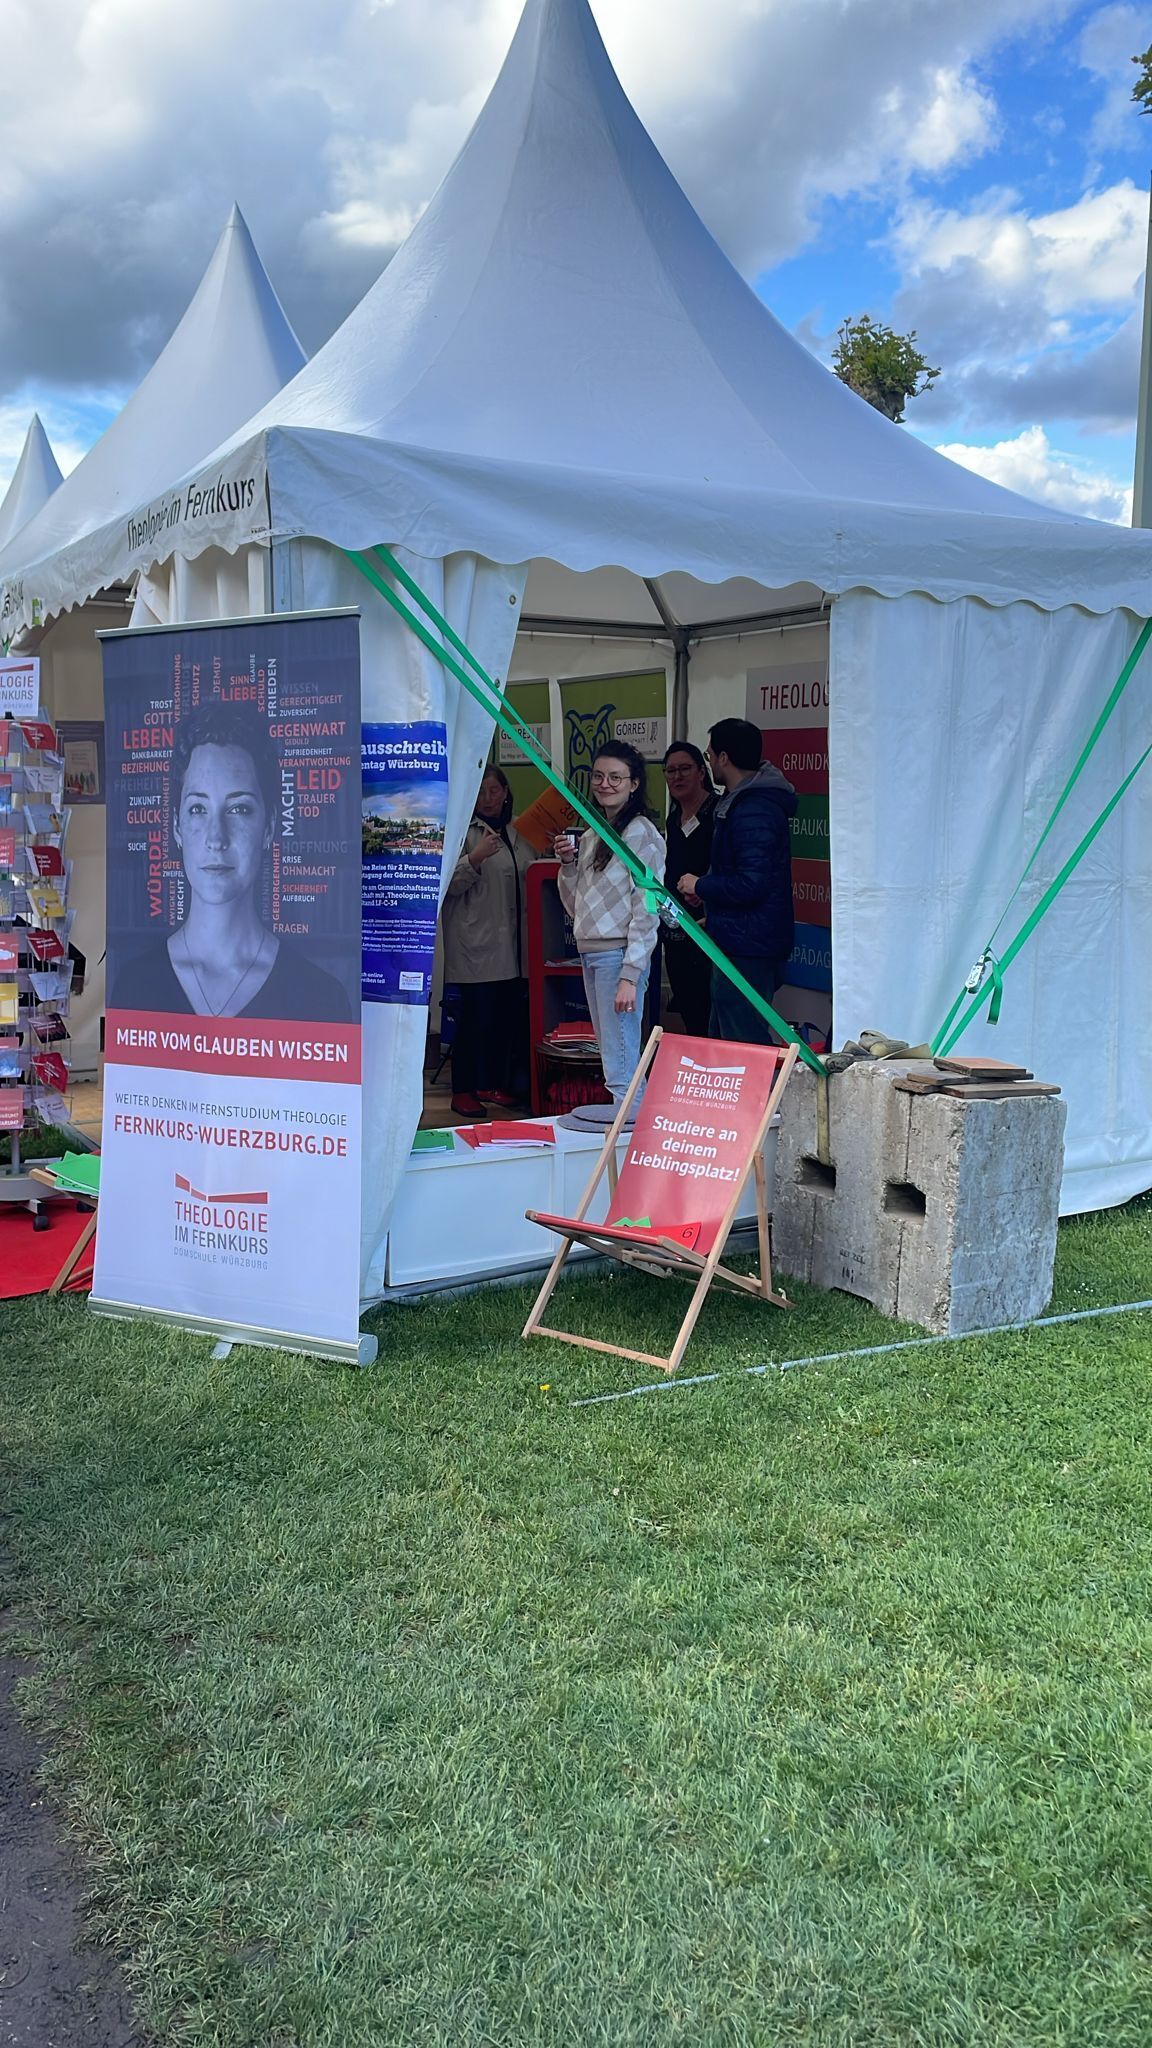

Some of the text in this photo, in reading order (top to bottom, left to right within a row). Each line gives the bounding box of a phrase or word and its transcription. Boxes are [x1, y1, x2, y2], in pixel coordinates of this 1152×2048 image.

[127, 474, 255, 551] Theologie im Fernkurs
[192, 664, 200, 706] SCHUTZ
[230, 675, 250, 686] SINN
[268, 658, 276, 717] FRIEDEN
[222, 686, 257, 701] LIEBE
[280, 694, 343, 707] GERECHTIGKEIT
[150, 700, 173, 709] TROST
[144, 712, 174, 726] GOTT
[280, 708, 318, 717] ZUVERSICHT
[269, 722, 346, 738] GEGENWART
[616, 722, 646, 736] GÖRRES
[123, 728, 174, 750] LEBEN
[132, 750, 173, 760] DANKBARKEIT
[284, 748, 333, 757] ZUFRIEDENHEIT
[122, 760, 170, 774] BEZIEHUNG
[278, 756, 351, 768] VERANTWORTUNG
[388, 759, 440, 772] Würzburg
[296, 768, 342, 790] LEID
[129, 796, 162, 806] ZUKUNFT
[282, 770, 294, 836] MACHT
[298, 794, 336, 804] TRAUER
[127, 808, 162, 824] GLÜCK
[162, 777, 170, 860] VERGANGENHEIT
[297, 806, 320, 818] TOD
[128, 842, 146, 852] SUCHE
[162, 860, 180, 870] GÜTE
[282, 856, 302, 864] KRISE
[147, 830, 162, 917] WÜRDE
[162, 870, 184, 878] ZWEIFEL
[282, 866, 336, 876] OHNMACHT
[404, 864, 437, 872] Personen
[272, 842, 280, 920] GEBORGENHEIT
[282, 884, 328, 894] SICHERHEIT
[792, 882, 831, 903] ASTORA
[282, 894, 315, 902] AUFBRUCH
[273, 923, 308, 934] FRAGEN
[116, 1028, 348, 1062] MEHR VOM GLAUBEN WISSEN
[676, 1070, 743, 1090] THEOLOGIE
[672, 1084, 740, 1103] IM FERNKURS
[116, 1092, 347, 1126] WEITER DENKEN IM FERNSTUDIUM THEOLOGIE
[114, 1114, 347, 1157] FERNKURS-WUERZBURG.DE
[652, 1115, 738, 1142] Studiere an
[662, 1137, 717, 1158] deinem
[630, 1150, 740, 1181] Lieblingsplatz!
[174, 1200, 268, 1233] THEOLOGIE
[174, 1225, 268, 1256] IM FERNKURS
[174, 1246, 268, 1270] DOMSCHULE WÜRZBURG
